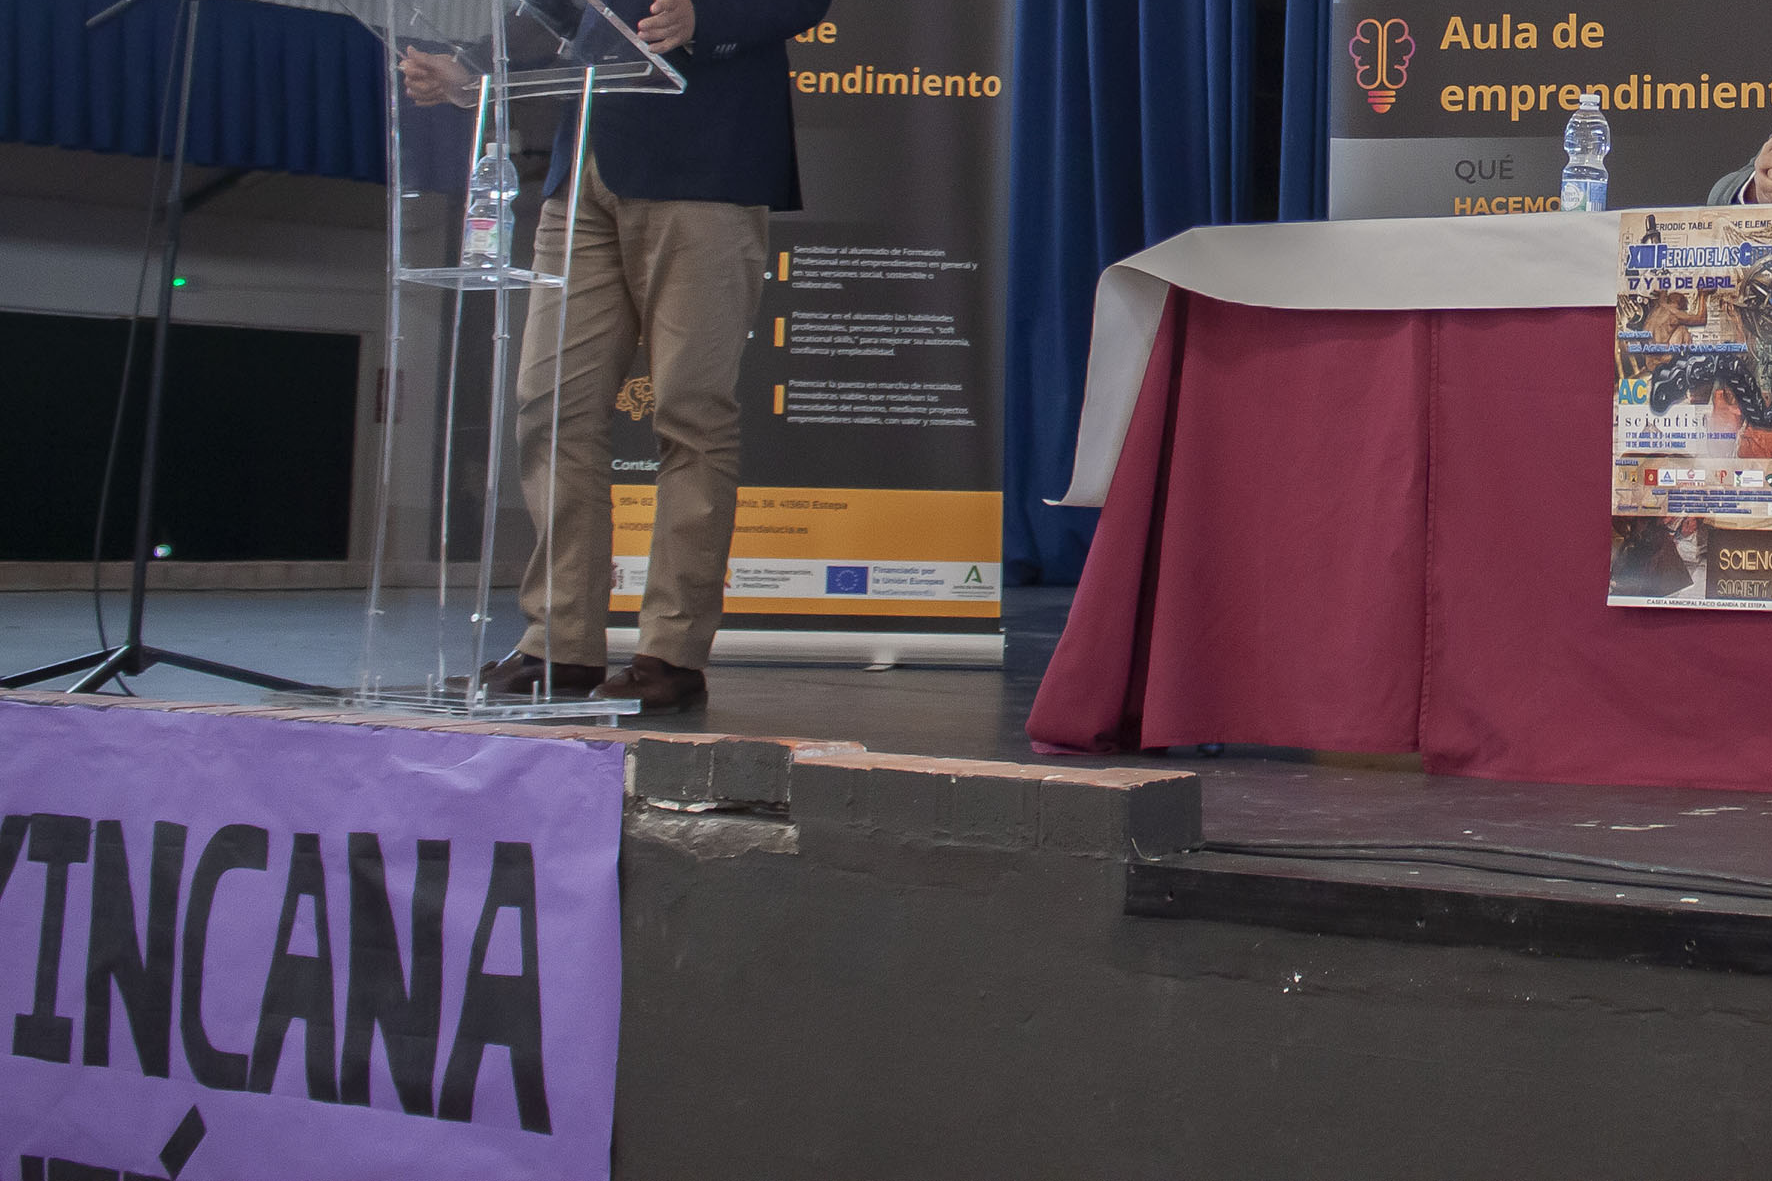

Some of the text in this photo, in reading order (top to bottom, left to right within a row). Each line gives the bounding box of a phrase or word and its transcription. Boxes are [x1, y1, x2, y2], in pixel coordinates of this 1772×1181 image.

[1440, 12, 1605, 50] Aula de
[789, 65, 1002, 98] endimiento
[1454, 154, 1515, 184] QUÉ
[1453, 195, 1562, 216] HACEMO
[1655, 222, 1686, 231] ERIODIC
[1687, 221, 1713, 230] TABLE
[1627, 276, 1736, 290] 17 Y 18 DE ABRIL
[1618, 378, 1648, 405] AC
[1625, 413, 1707, 427] scientist
[611, 458, 661, 472] Contác
[1717, 579, 1770, 598] SOCIETY
